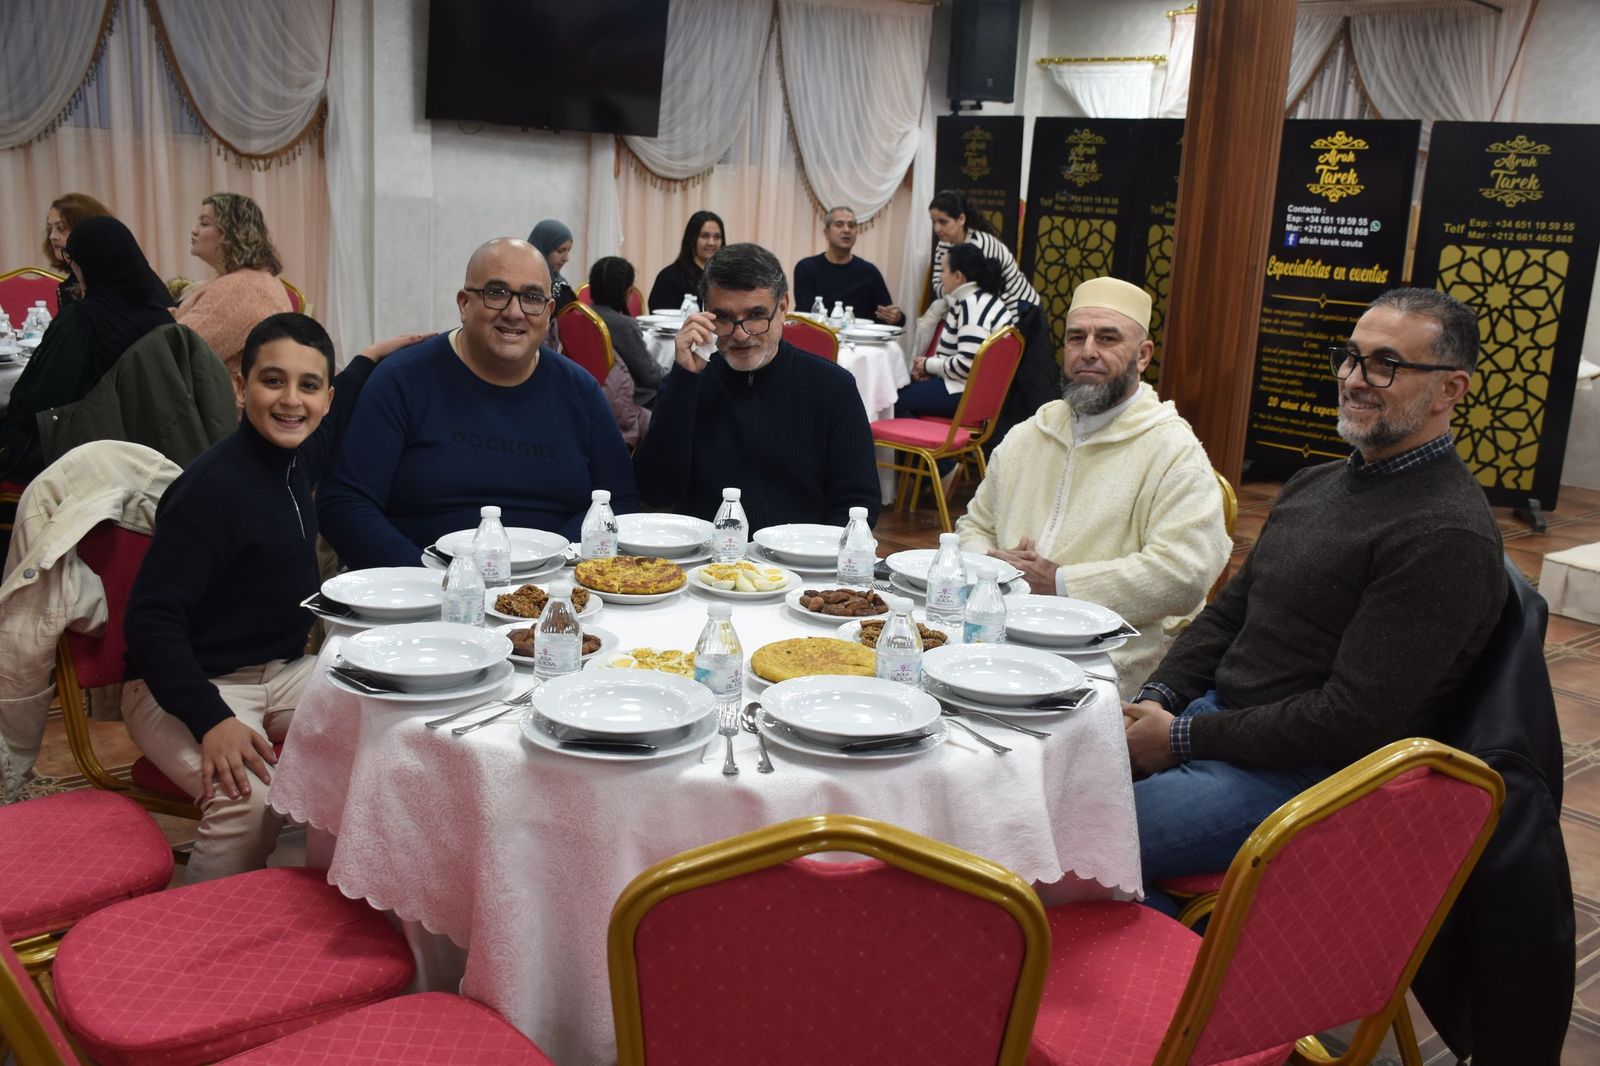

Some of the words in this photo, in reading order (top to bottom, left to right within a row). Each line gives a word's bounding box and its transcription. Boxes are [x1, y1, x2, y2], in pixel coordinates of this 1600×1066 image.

[1318, 149, 1356, 166] Afrah
[1494, 154, 1538, 170] Afrah
[1316, 164, 1358, 184] Tarek
[1490, 169, 1541, 190] Tarek
[1288, 204, 1322, 214] Contacto
[1286, 214, 1304, 224] Esp:
[1305, 215, 1319, 224] +34
[1320, 216, 1334, 225] 651
[1336, 216, 1346, 226] 19
[1358, 218, 1368, 226] 55
[1495, 219, 1513, 228] +34
[1514, 220, 1532, 230] 651
[1535, 220, 1546, 230] 19
[1548, 221, 1560, 230] 59
[1562, 222, 1576, 231] 55
[1286, 224, 1302, 232] Mar:
[1304, 224, 1322, 234] +212
[1338, 226, 1353, 236] 465
[1444, 222, 1466, 234] Telf
[1299, 236, 1319, 246] afrah
[1320, 237, 1340, 247] tarek
[1341, 238, 1363, 248] ceuta
[1492, 232, 1514, 242] +212
[1535, 232, 1554, 242] 465
[1266, 255, 1332, 280] Especialistas
[1333, 266, 1346, 279] en
[1349, 264, 1389, 284] eventos
